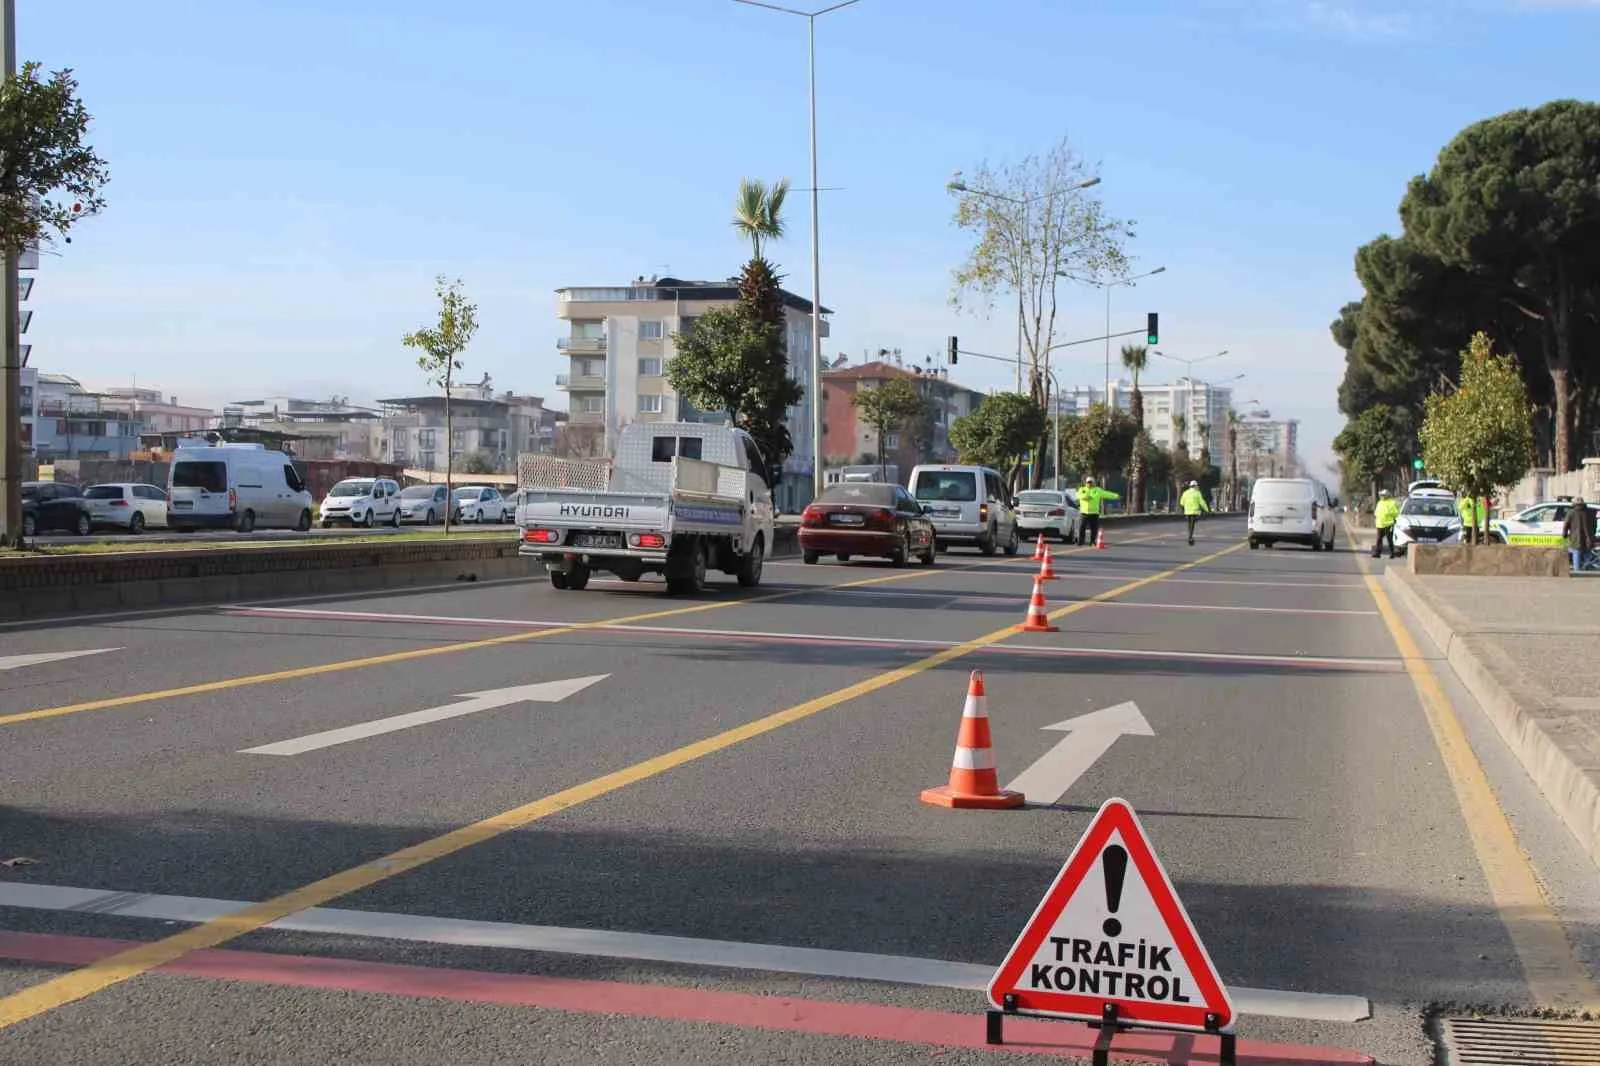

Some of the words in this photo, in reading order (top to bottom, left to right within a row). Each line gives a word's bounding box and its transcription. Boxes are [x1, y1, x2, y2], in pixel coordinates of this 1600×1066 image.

[560, 504, 630, 518] HYUNDAI
[1050, 936, 1173, 972] TRAFİK
[1031, 963, 1190, 1003] KONTROL
